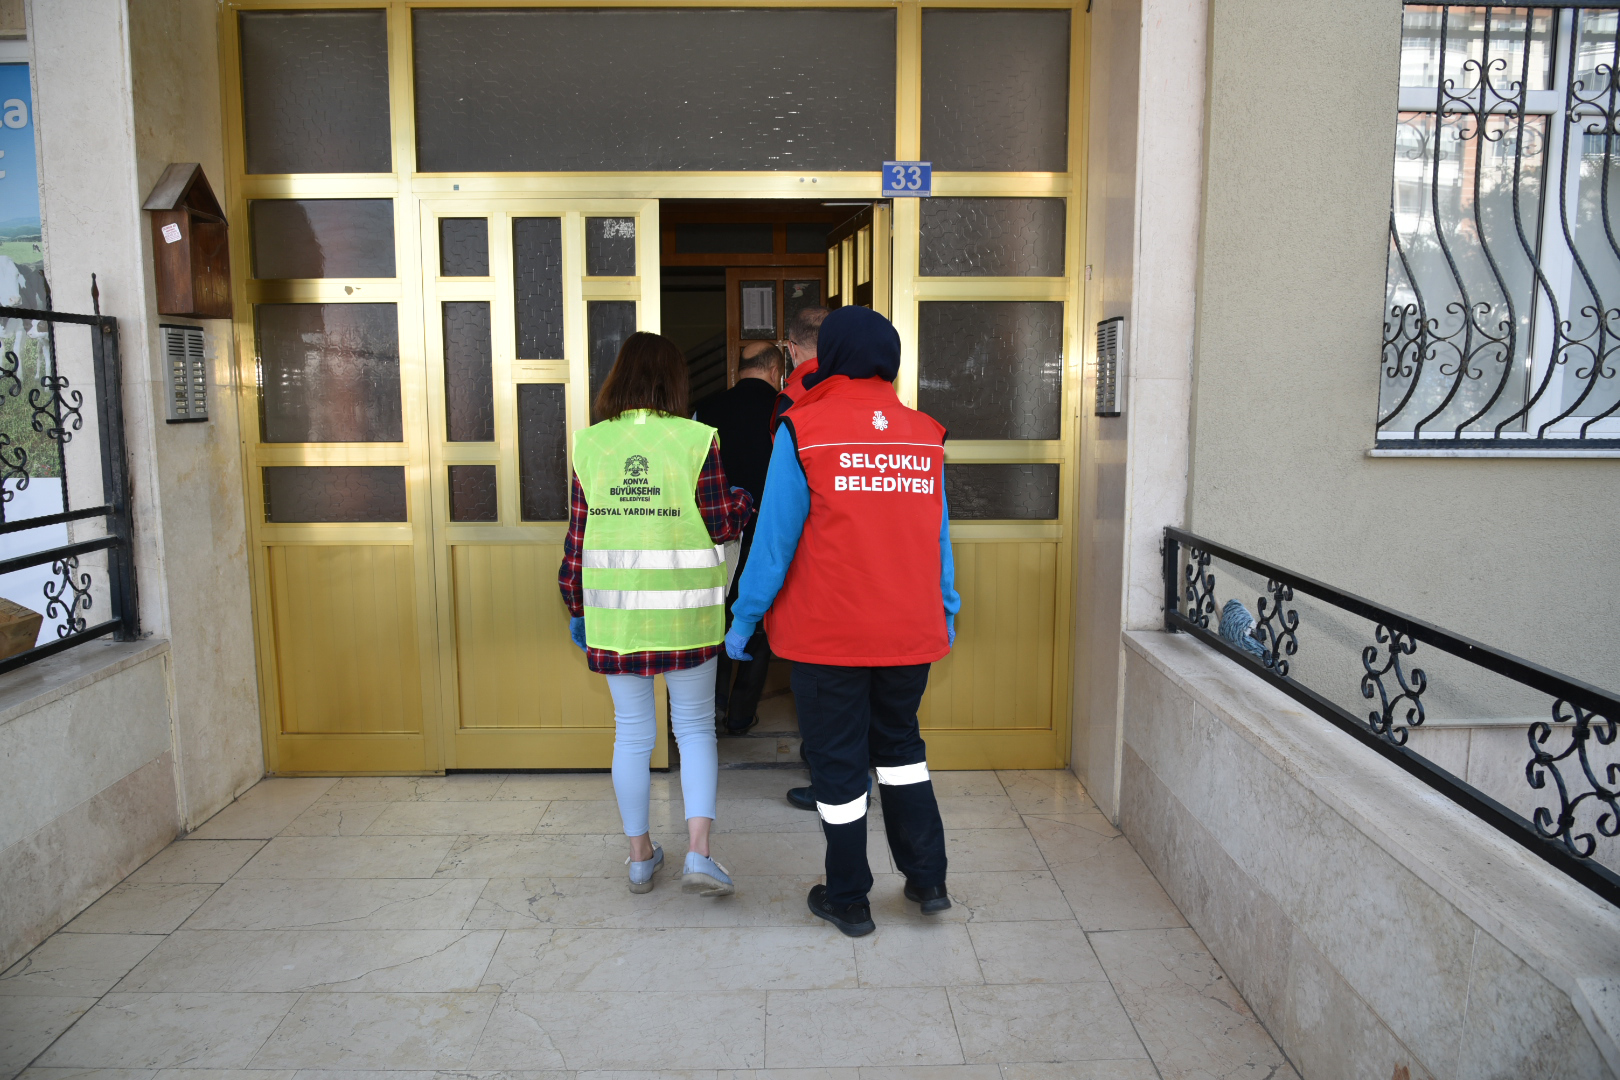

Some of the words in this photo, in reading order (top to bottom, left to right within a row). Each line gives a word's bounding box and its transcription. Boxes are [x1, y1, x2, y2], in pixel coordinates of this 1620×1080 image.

[0, 98, 28, 129] a
[891, 165, 922, 190] 33
[839, 452, 931, 473] SELÇUKLU
[610, 486, 661, 496] BÜYÜKŞEHİR
[834, 473, 935, 495] BELEDİYESİ
[589, 508, 622, 516] SOSYAL
[623, 508, 656, 516] YARDIM
[657, 507, 681, 517] EKİBİ
